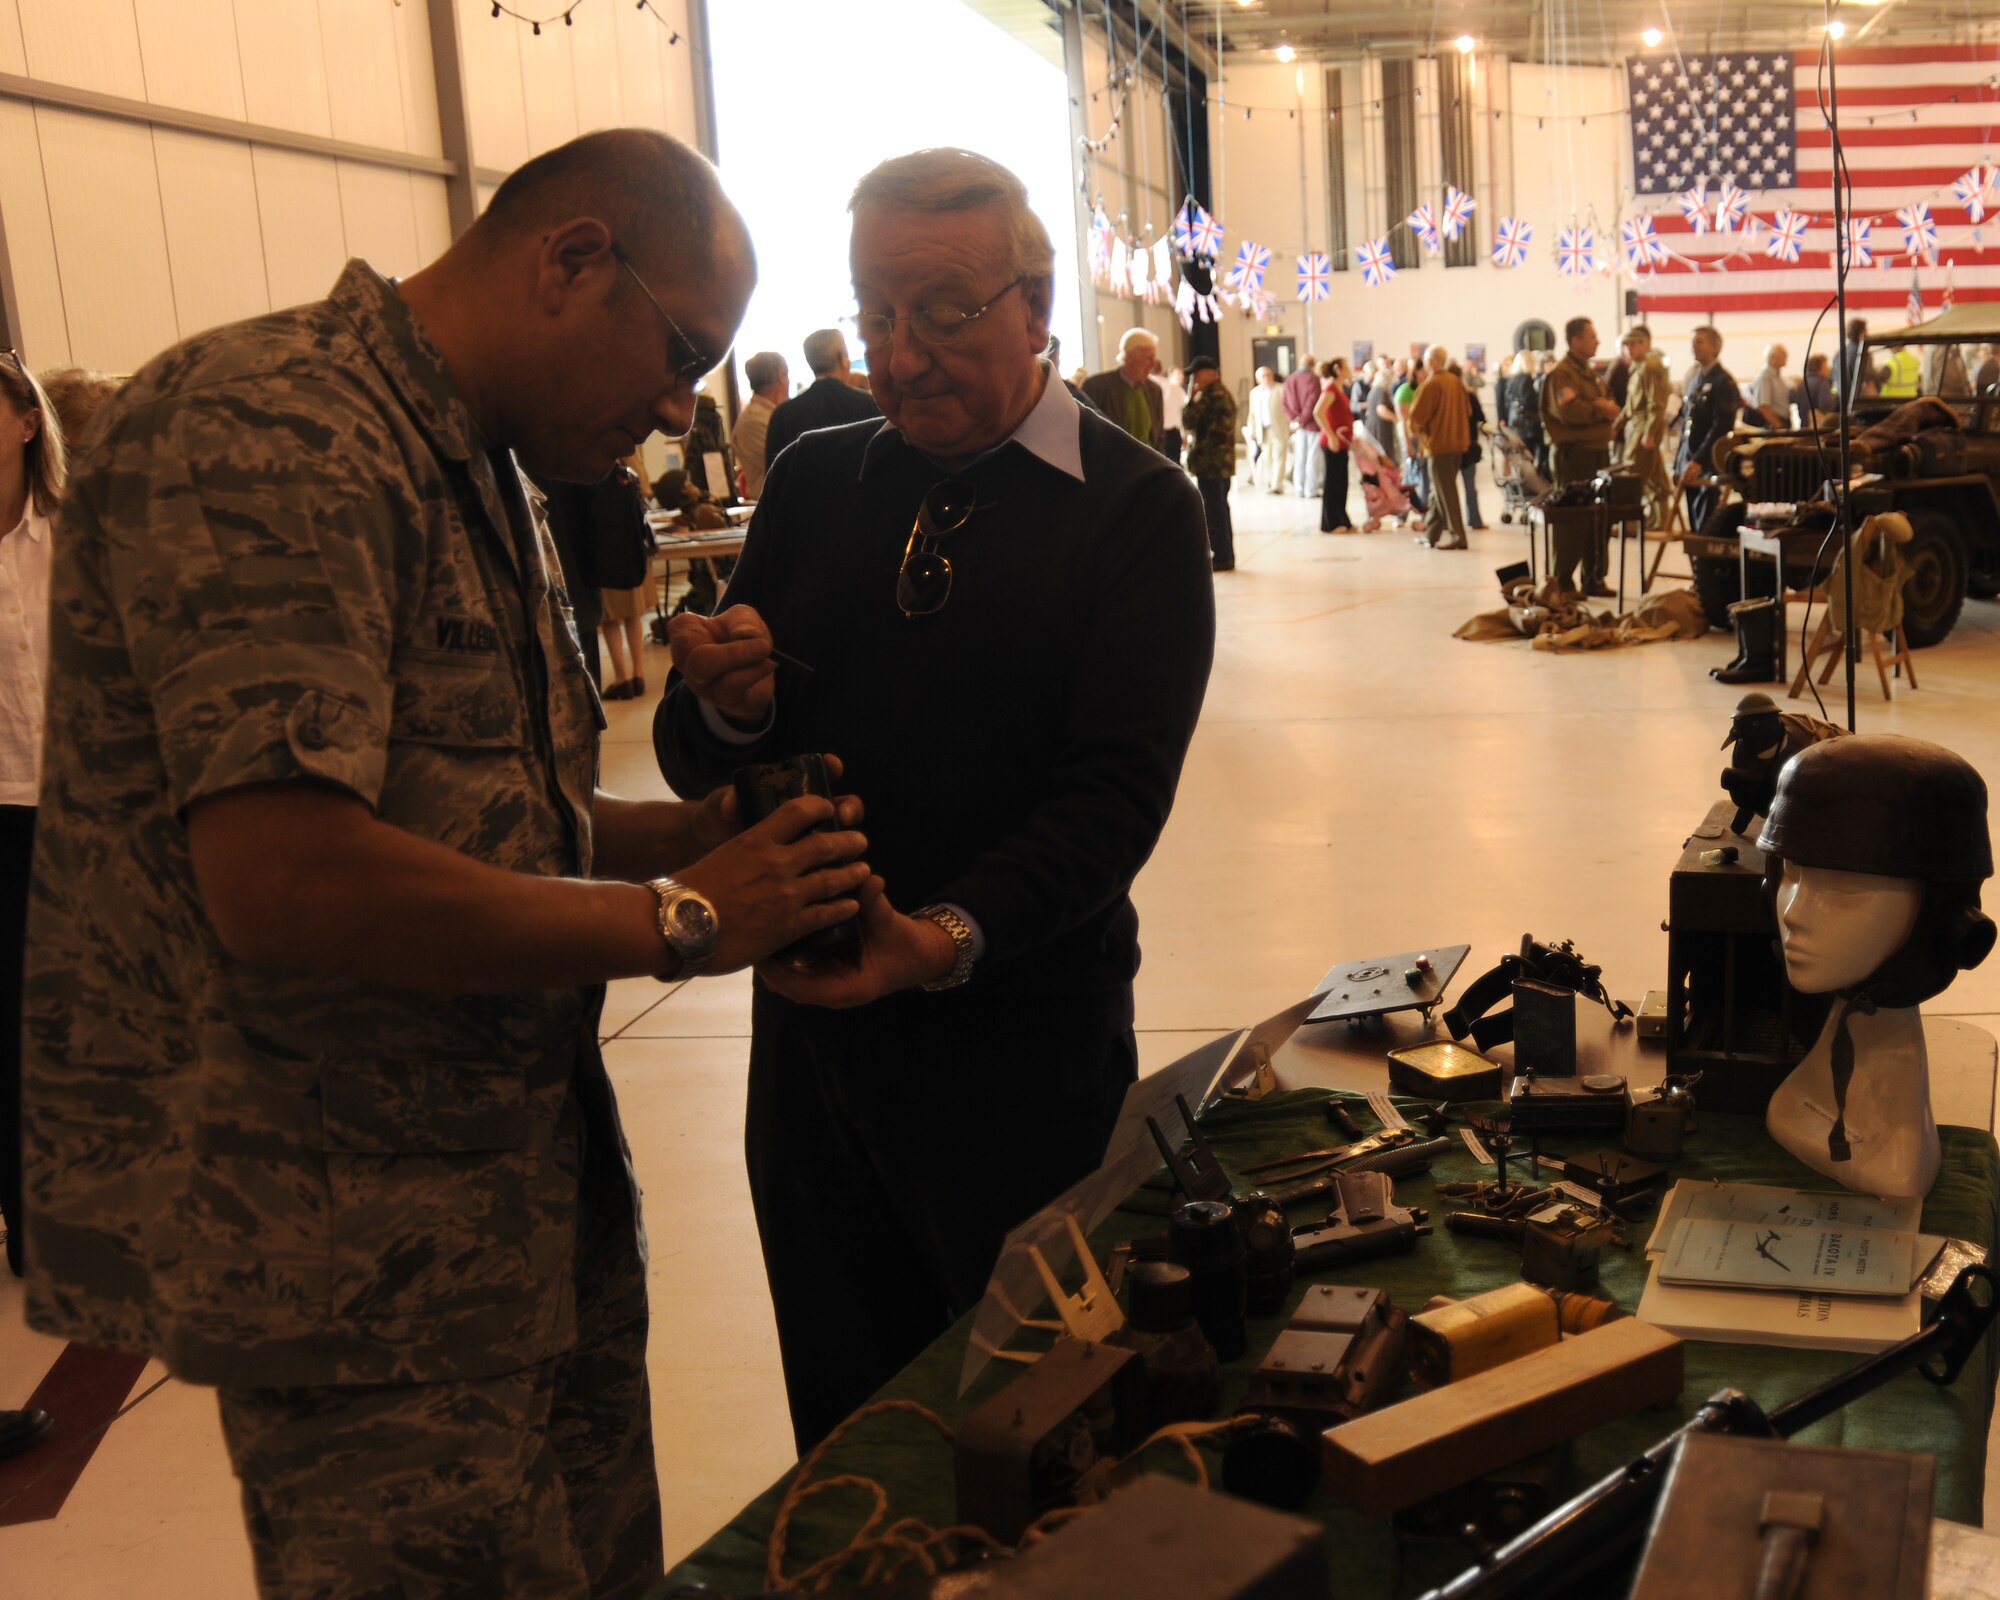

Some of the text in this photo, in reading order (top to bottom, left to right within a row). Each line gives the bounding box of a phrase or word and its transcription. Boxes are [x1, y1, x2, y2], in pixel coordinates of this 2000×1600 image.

[1823, 1233, 1843, 1277] DAKOTA IV
[1855, 1256, 1868, 1275] NOTES
